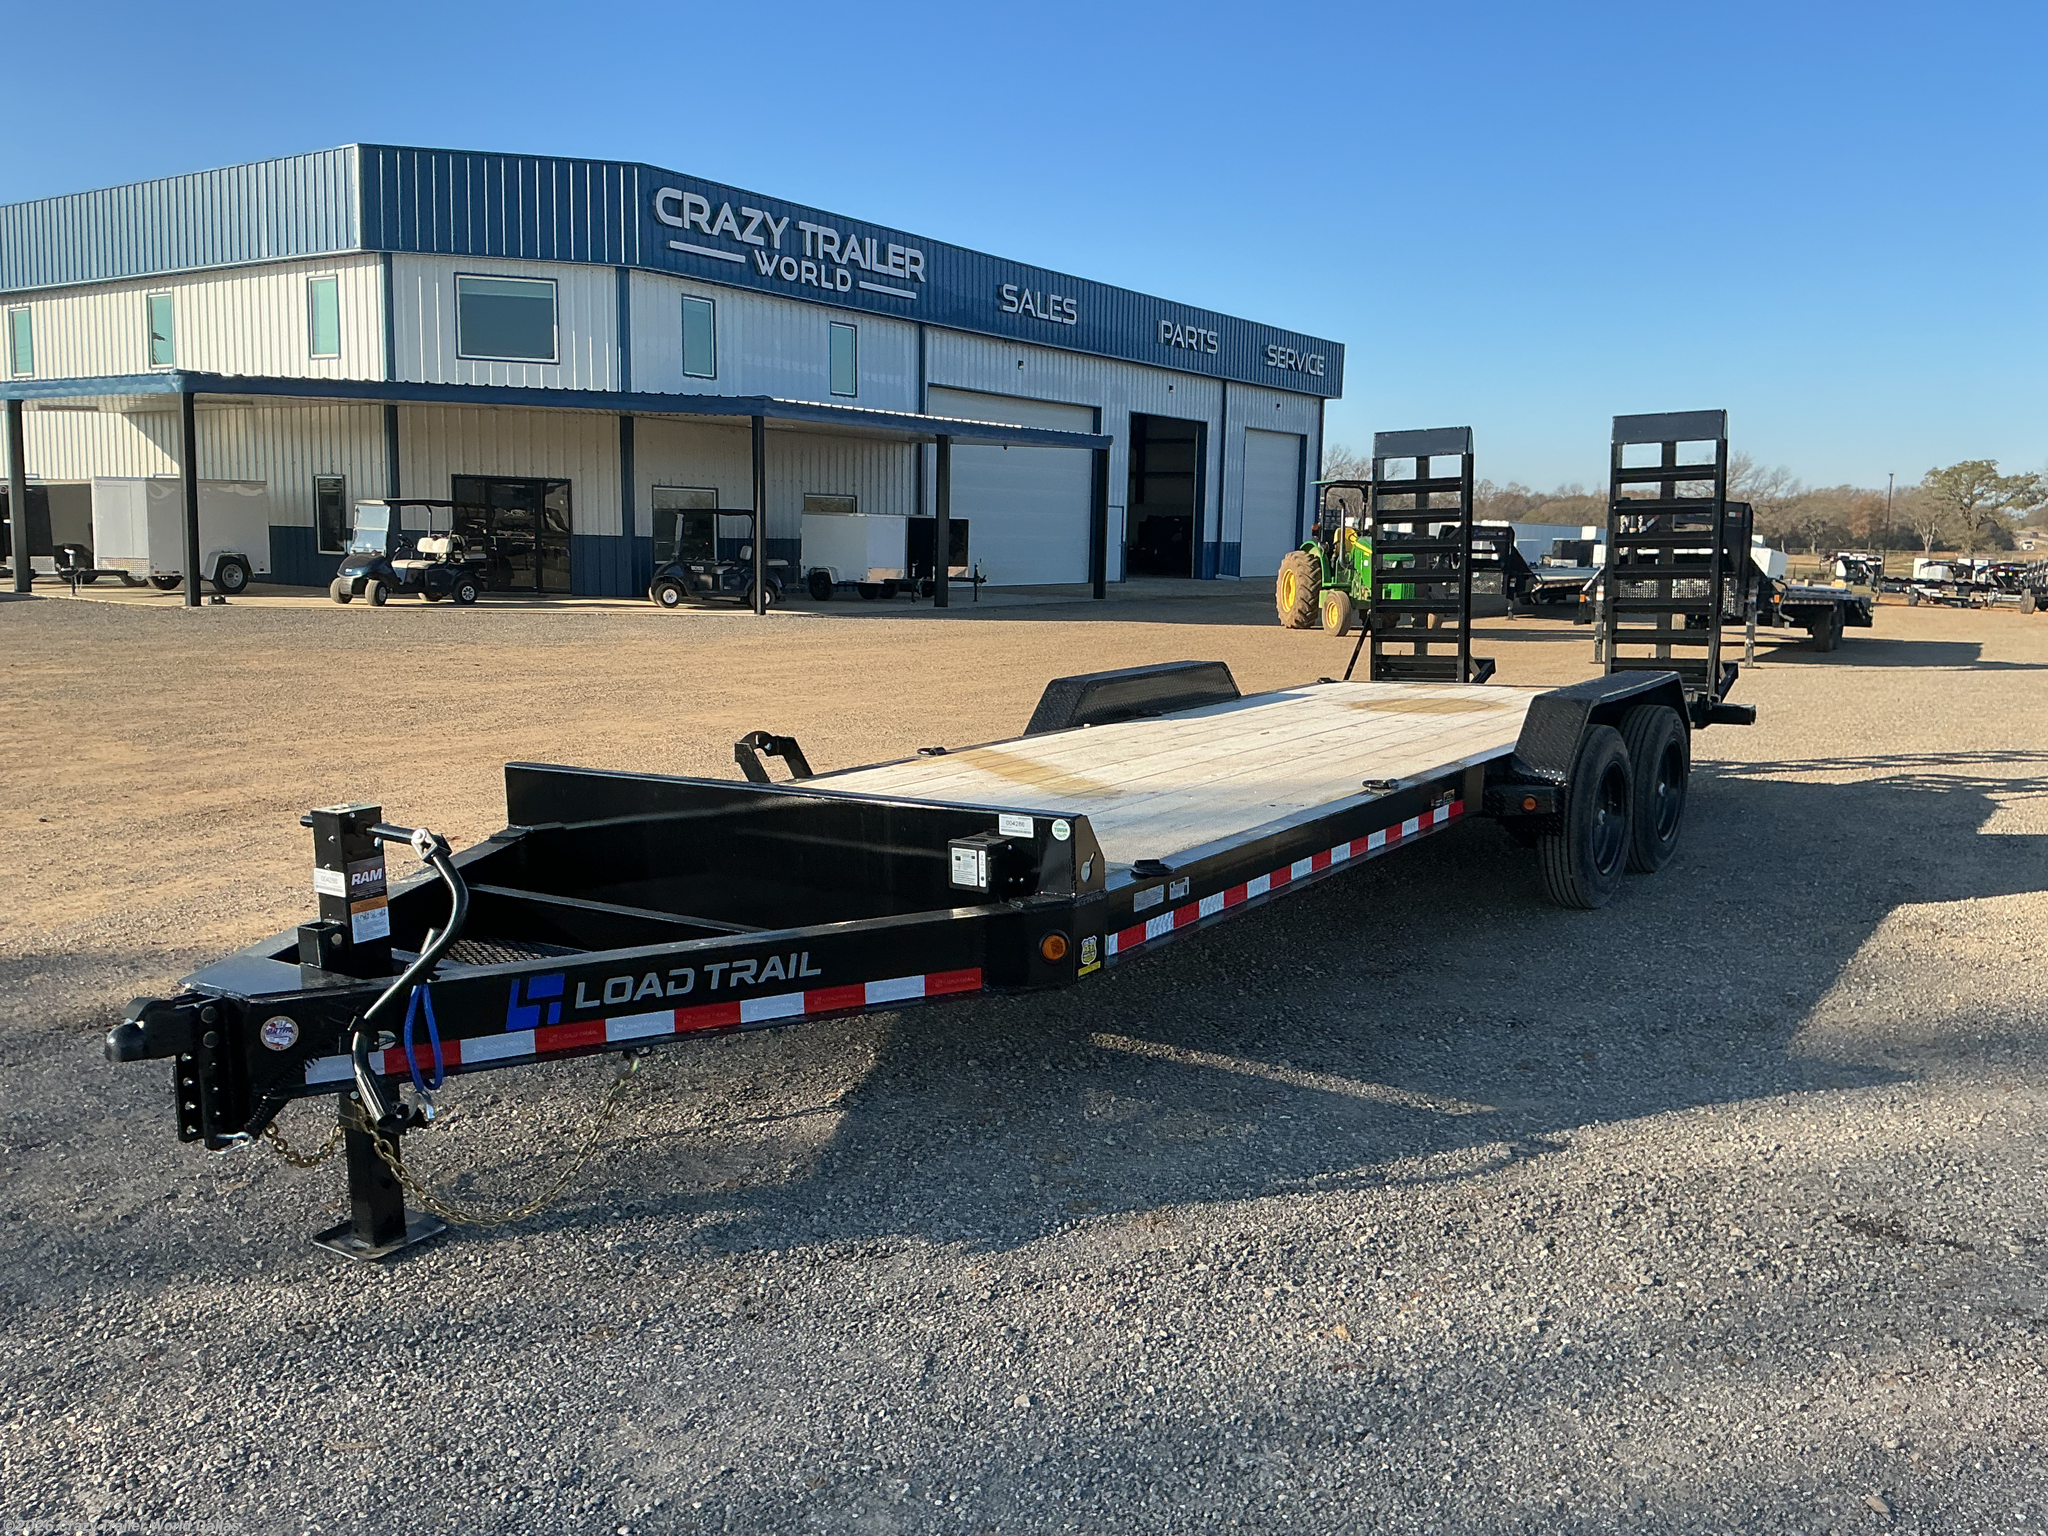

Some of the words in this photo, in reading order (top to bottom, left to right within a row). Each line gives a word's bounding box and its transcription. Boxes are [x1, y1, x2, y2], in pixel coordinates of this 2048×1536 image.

[655, 187, 789, 249] CRAZY
[799, 220, 925, 283] TRAILER
[754, 249, 851, 292] WORLD
[1001, 283, 1077, 325] SALES
[1160, 319, 1219, 355] PARTS
[1266, 344, 1325, 376] SERVICE
[351, 868, 383, 886] RAM
[575, 967, 695, 1009] LOAD
[704, 951, 822, 990] TRAIL
